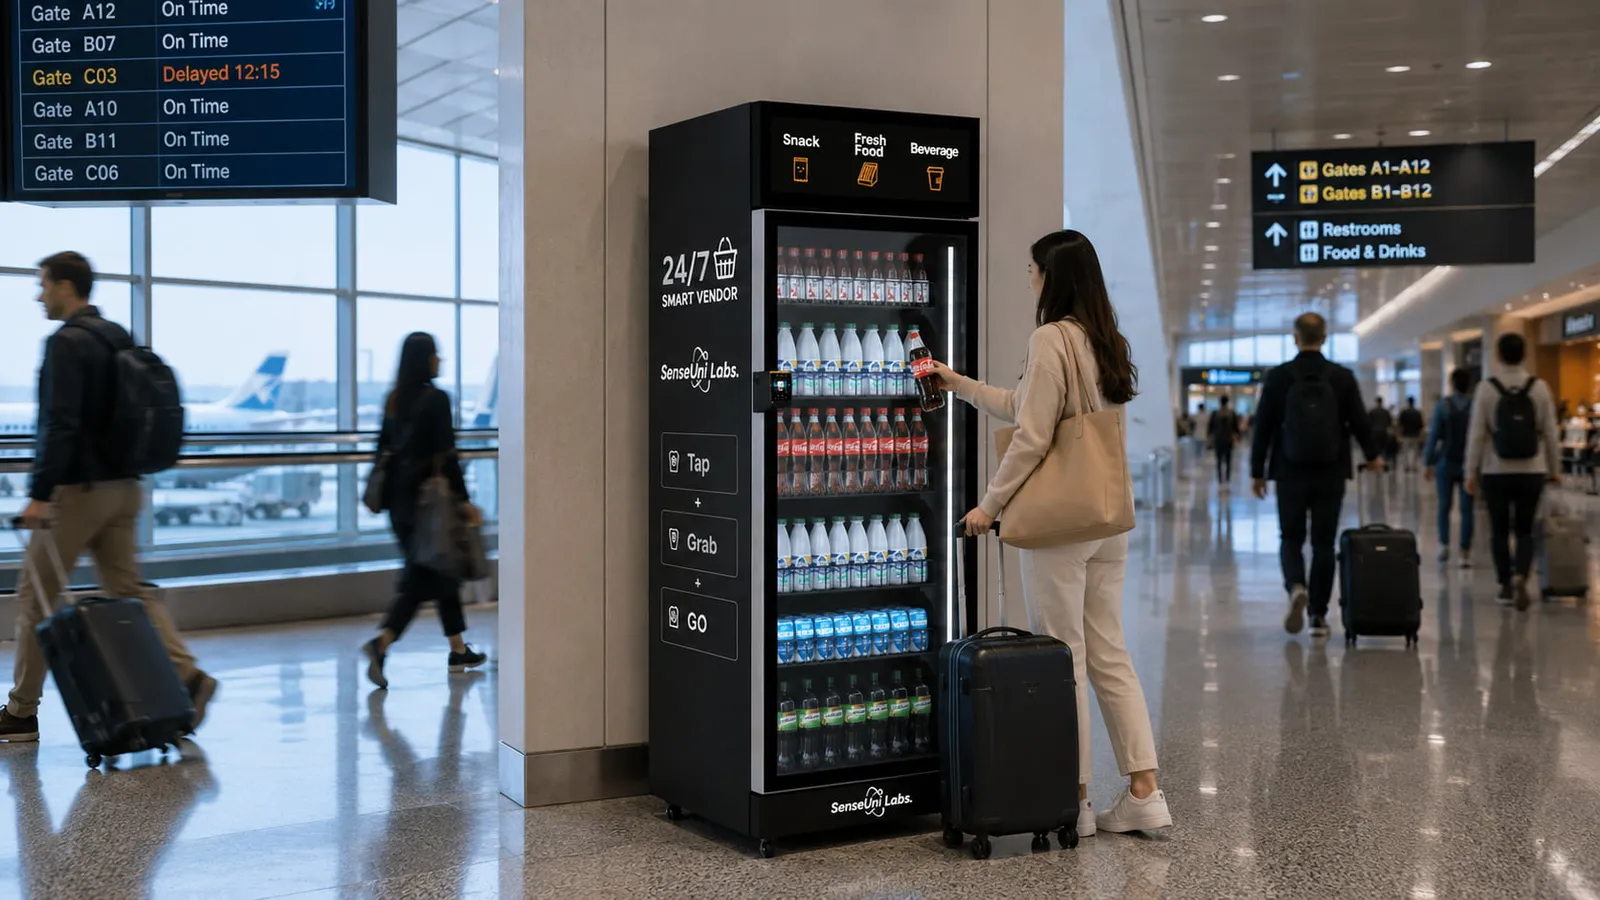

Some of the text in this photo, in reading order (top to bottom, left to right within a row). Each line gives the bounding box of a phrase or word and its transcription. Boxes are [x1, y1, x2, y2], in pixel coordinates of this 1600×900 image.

[31, 3, 116, 22] Gate A12
[161, 0, 229, 17] On Time
[32, 36, 116, 54] Gate B07
[162, 33, 229, 50] On Time
[32, 68, 117, 86] Gate C03
[163, 64, 280, 85] Delayed 12:15
[33, 101, 118, 118] Gate A10
[163, 98, 229, 115] On Time
[34, 133, 116, 150] Gate B11
[163, 131, 230, 148] On Time
[782, 134, 820, 148] Snack
[854, 133, 887, 146] Fresh
[854, 145, 884, 158] Food
[910, 142, 960, 160] Beverage
[34, 165, 119, 182] Gate C06
[164, 164, 230, 180] On Time
[1321, 163, 1367, 178] Gates
[1322, 186, 1367, 201] Gates
[1322, 223, 1402, 237] Restrooms
[1323, 244, 1427, 260] Food & Drinks
[662, 250, 710, 287] 24/7
[661, 287, 738, 308] SMART VENDOR
[660, 360, 740, 381] SenseUni Labs.
[687, 453, 710, 477] Tap
[687, 533, 718, 555] Grab
[687, 612, 708, 633] GO
[831, 793, 913, 814] SenseUni Labs.
